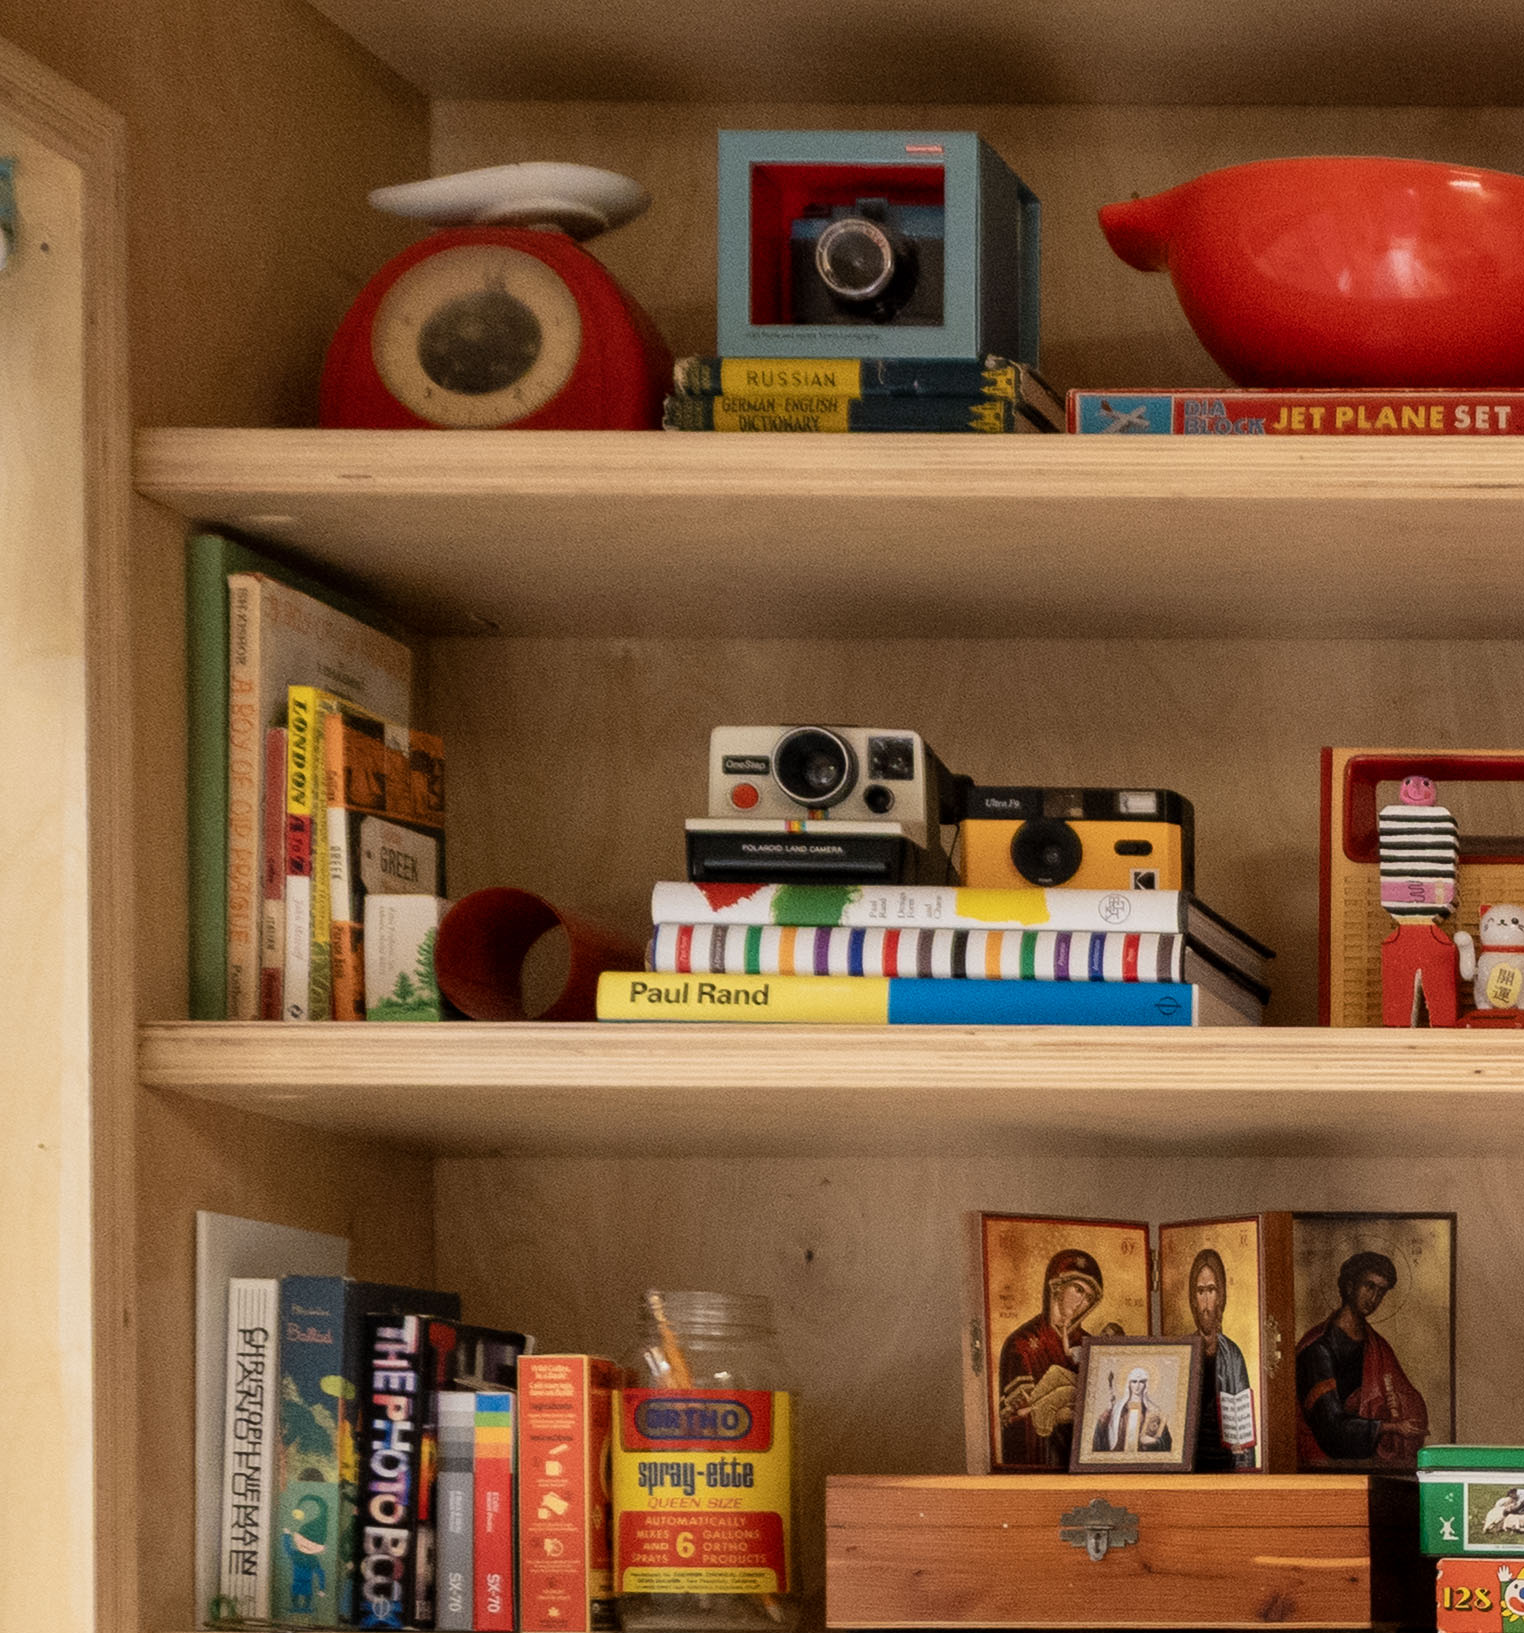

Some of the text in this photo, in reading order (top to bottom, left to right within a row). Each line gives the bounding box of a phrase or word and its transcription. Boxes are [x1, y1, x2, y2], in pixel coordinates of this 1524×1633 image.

[745, 369, 836, 389] RUSSIAN
[1271, 404, 1512, 431] JET PLANE SET
[290, 698, 308, 807] LONDON
[725, 759, 768, 772] OneStep
[741, 843, 844, 855] POLAROID LAND CAMERA
[379, 845, 419, 884] GREEK
[629, 981, 770, 1006] Paul Rand
[646, 1408, 740, 1431] ORTHO
[229, 1329, 252, 1575] PIANO FORTE
[241, 1327, 269, 1576] CHRISTOPH NIEMANN
[638, 1457, 754, 1496] spray-ette
[647, 1497, 743, 1509] QUEEN SIZE
[645, 1516, 746, 1526] AUTOMATICALLY
[636, 1529, 670, 1539] MIXES
[675, 1531, 696, 1558] 6
[702, 1529, 760, 1540] GALLONS
[643, 1542, 669, 1551] AND
[703, 1542, 748, 1552] ORTHO
[631, 1554, 669, 1563] SPRAYS
[702, 1553, 768, 1564] PRODUCTS
[449, 1572, 463, 1612] SX-70
[486, 1573, 501, 1613] SX-70
[1441, 1586, 1493, 1611] 128
